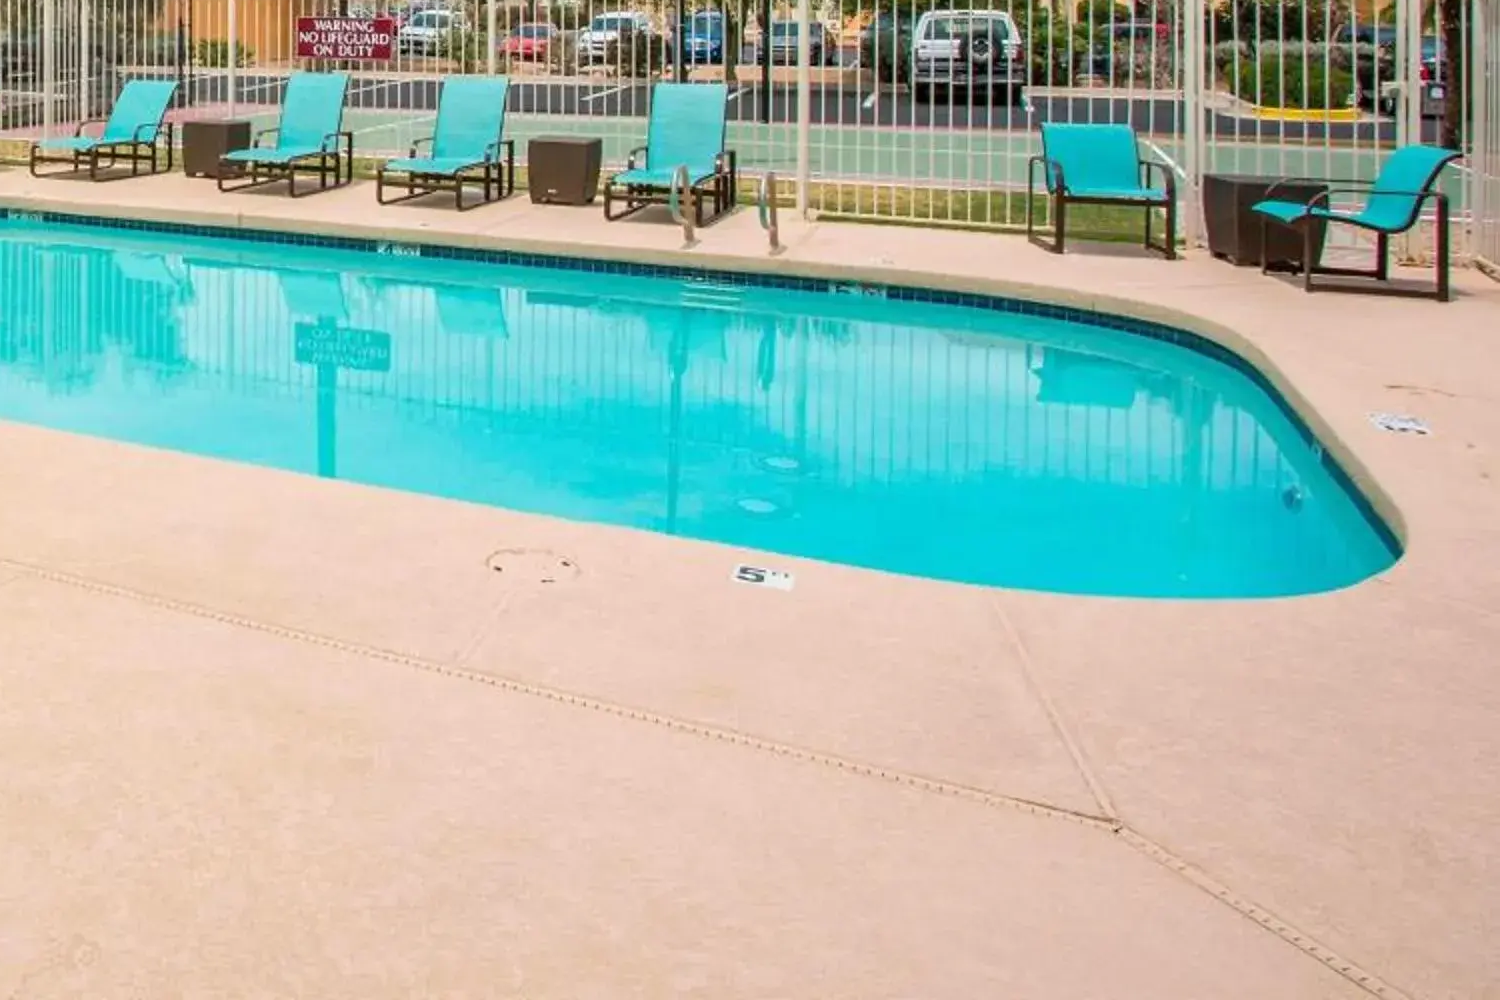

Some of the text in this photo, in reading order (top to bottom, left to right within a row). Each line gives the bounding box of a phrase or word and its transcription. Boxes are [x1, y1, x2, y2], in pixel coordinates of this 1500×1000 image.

[314, 19, 374, 32] WARNING
[299, 31, 389, 45] NO LIFEGUARD
[313, 44, 374, 57] ON DUTY
[737, 566, 766, 583] 5
